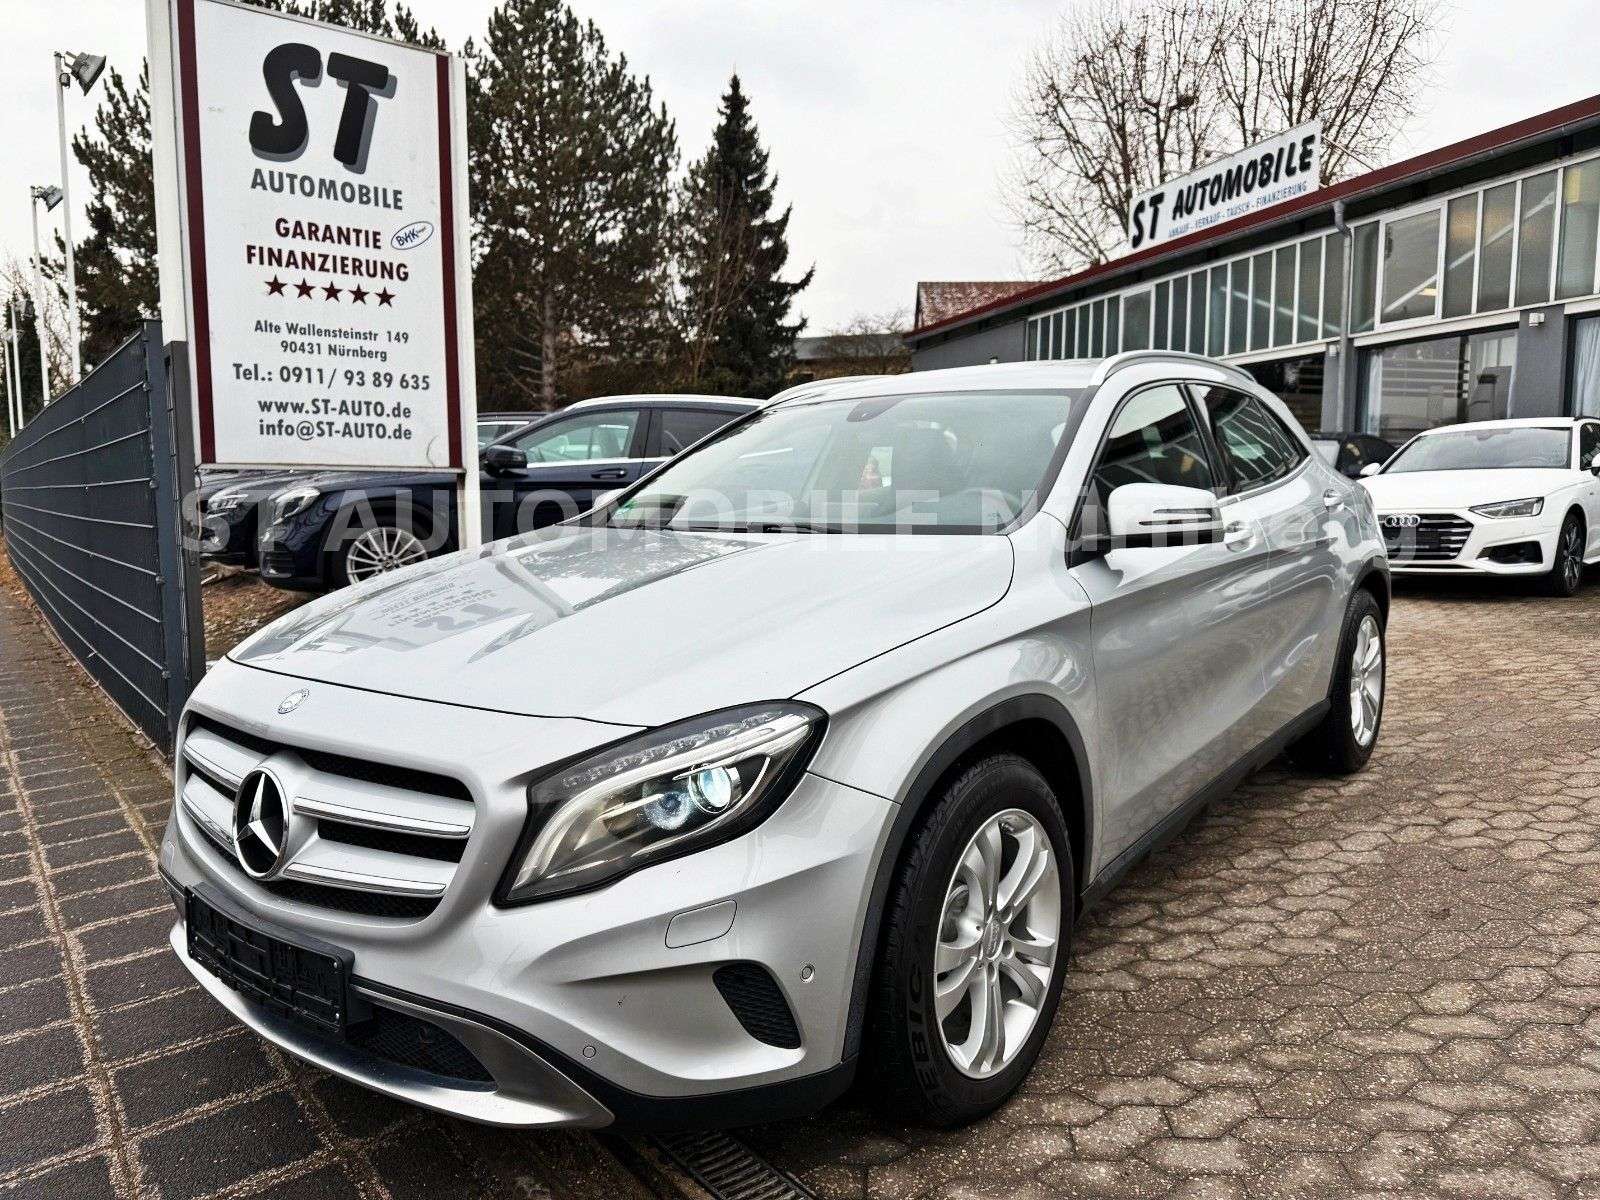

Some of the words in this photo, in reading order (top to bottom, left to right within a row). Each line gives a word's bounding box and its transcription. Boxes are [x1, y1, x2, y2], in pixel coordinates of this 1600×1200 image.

[249, 42, 397, 174] ST
[251, 168, 403, 210] AUTOMOBILE
[1132, 193, 1164, 249] ST
[1172, 134, 1315, 220] AUTOMOBILE
[1227, 201, 1250, 217] TAUSCH
[1256, 181, 1307, 208] FINANZIERUNG
[275, 217, 382, 250] GARANTIE
[246, 244, 409, 282] FINANZIERUNG
[254, 320, 281, 334] Alte
[285, 322, 379, 342] Wallensteinstr
[386, 331, 409, 344] 149
[280, 341, 322, 355] 90431
[328, 343, 388, 362] Nürnberg
[233, 363, 273, 382] Tel.:
[344, 369, 365, 387] 93
[373, 371, 393, 389] 89
[400, 374, 430, 391] 635
[258, 398, 411, 418] www.ST-AUTO.de
[259, 419, 412, 441] info@ST-AUTO.de
